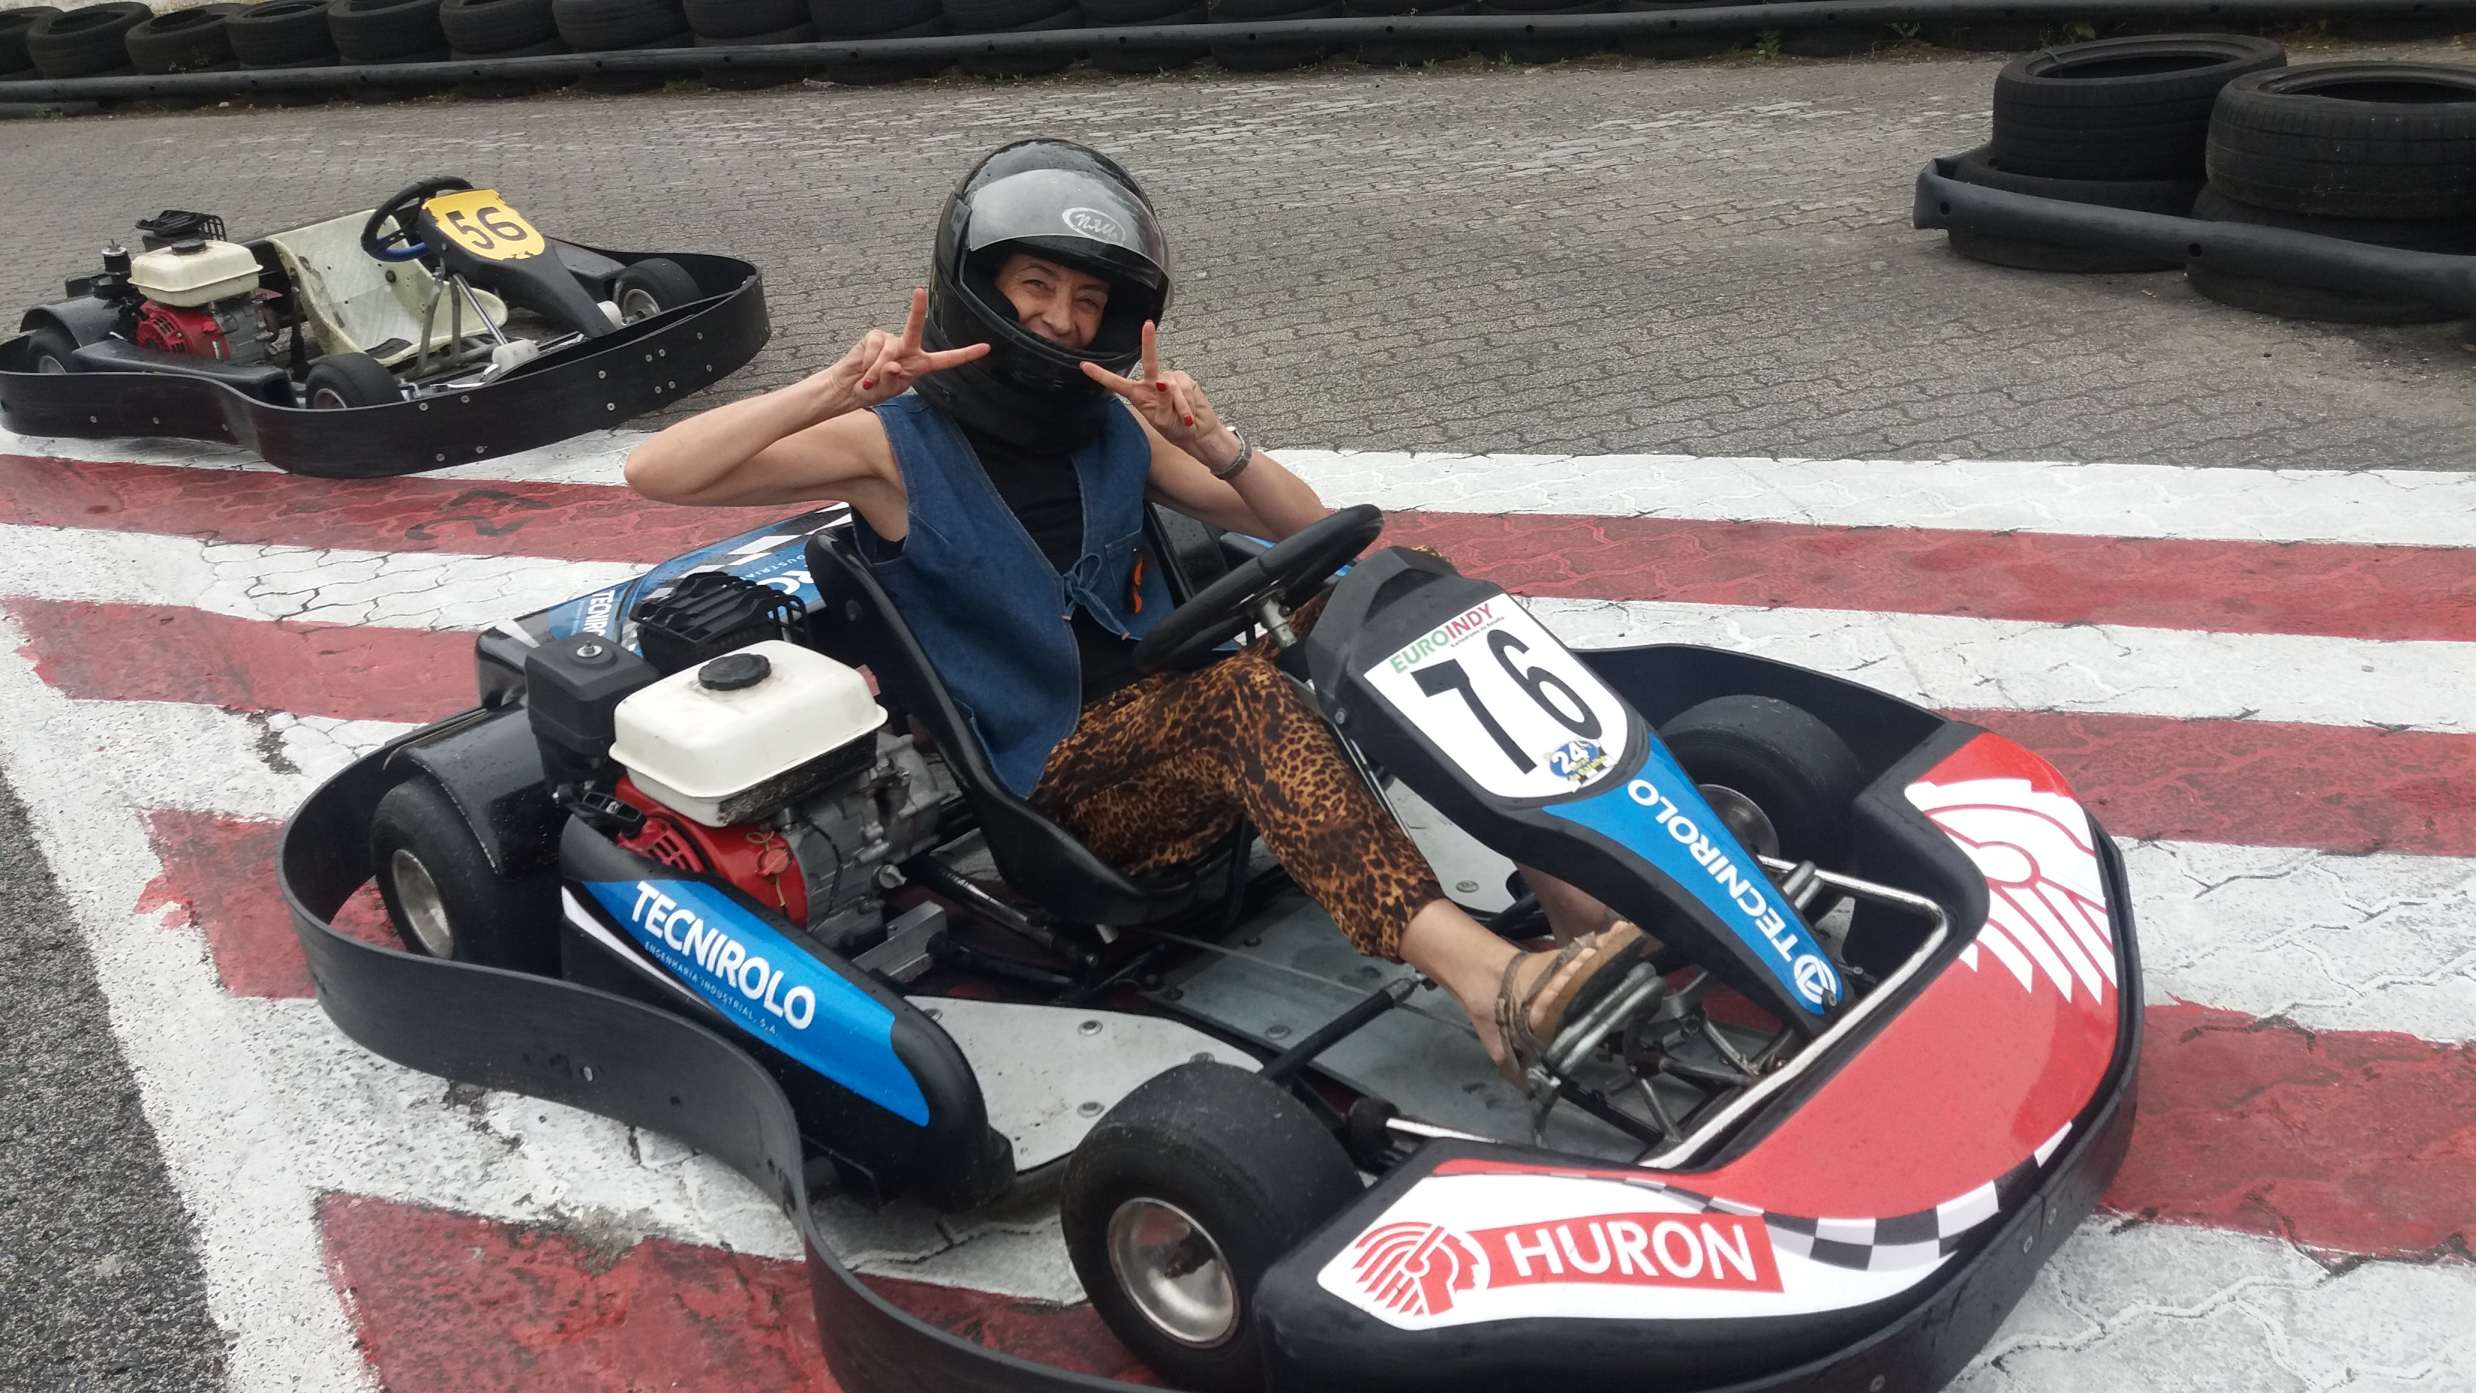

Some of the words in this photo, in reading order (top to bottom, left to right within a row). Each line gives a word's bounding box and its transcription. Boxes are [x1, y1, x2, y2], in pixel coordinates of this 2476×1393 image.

[445, 206, 528, 250] 56
[1410, 629, 1602, 775] 76
[1628, 779, 1798, 962] TECNIROLO
[631, 880, 816, 1030] TECNIROLO
[644, 941, 698, 983] ENGENHARIA
[1504, 1219, 1758, 1282] HURON
